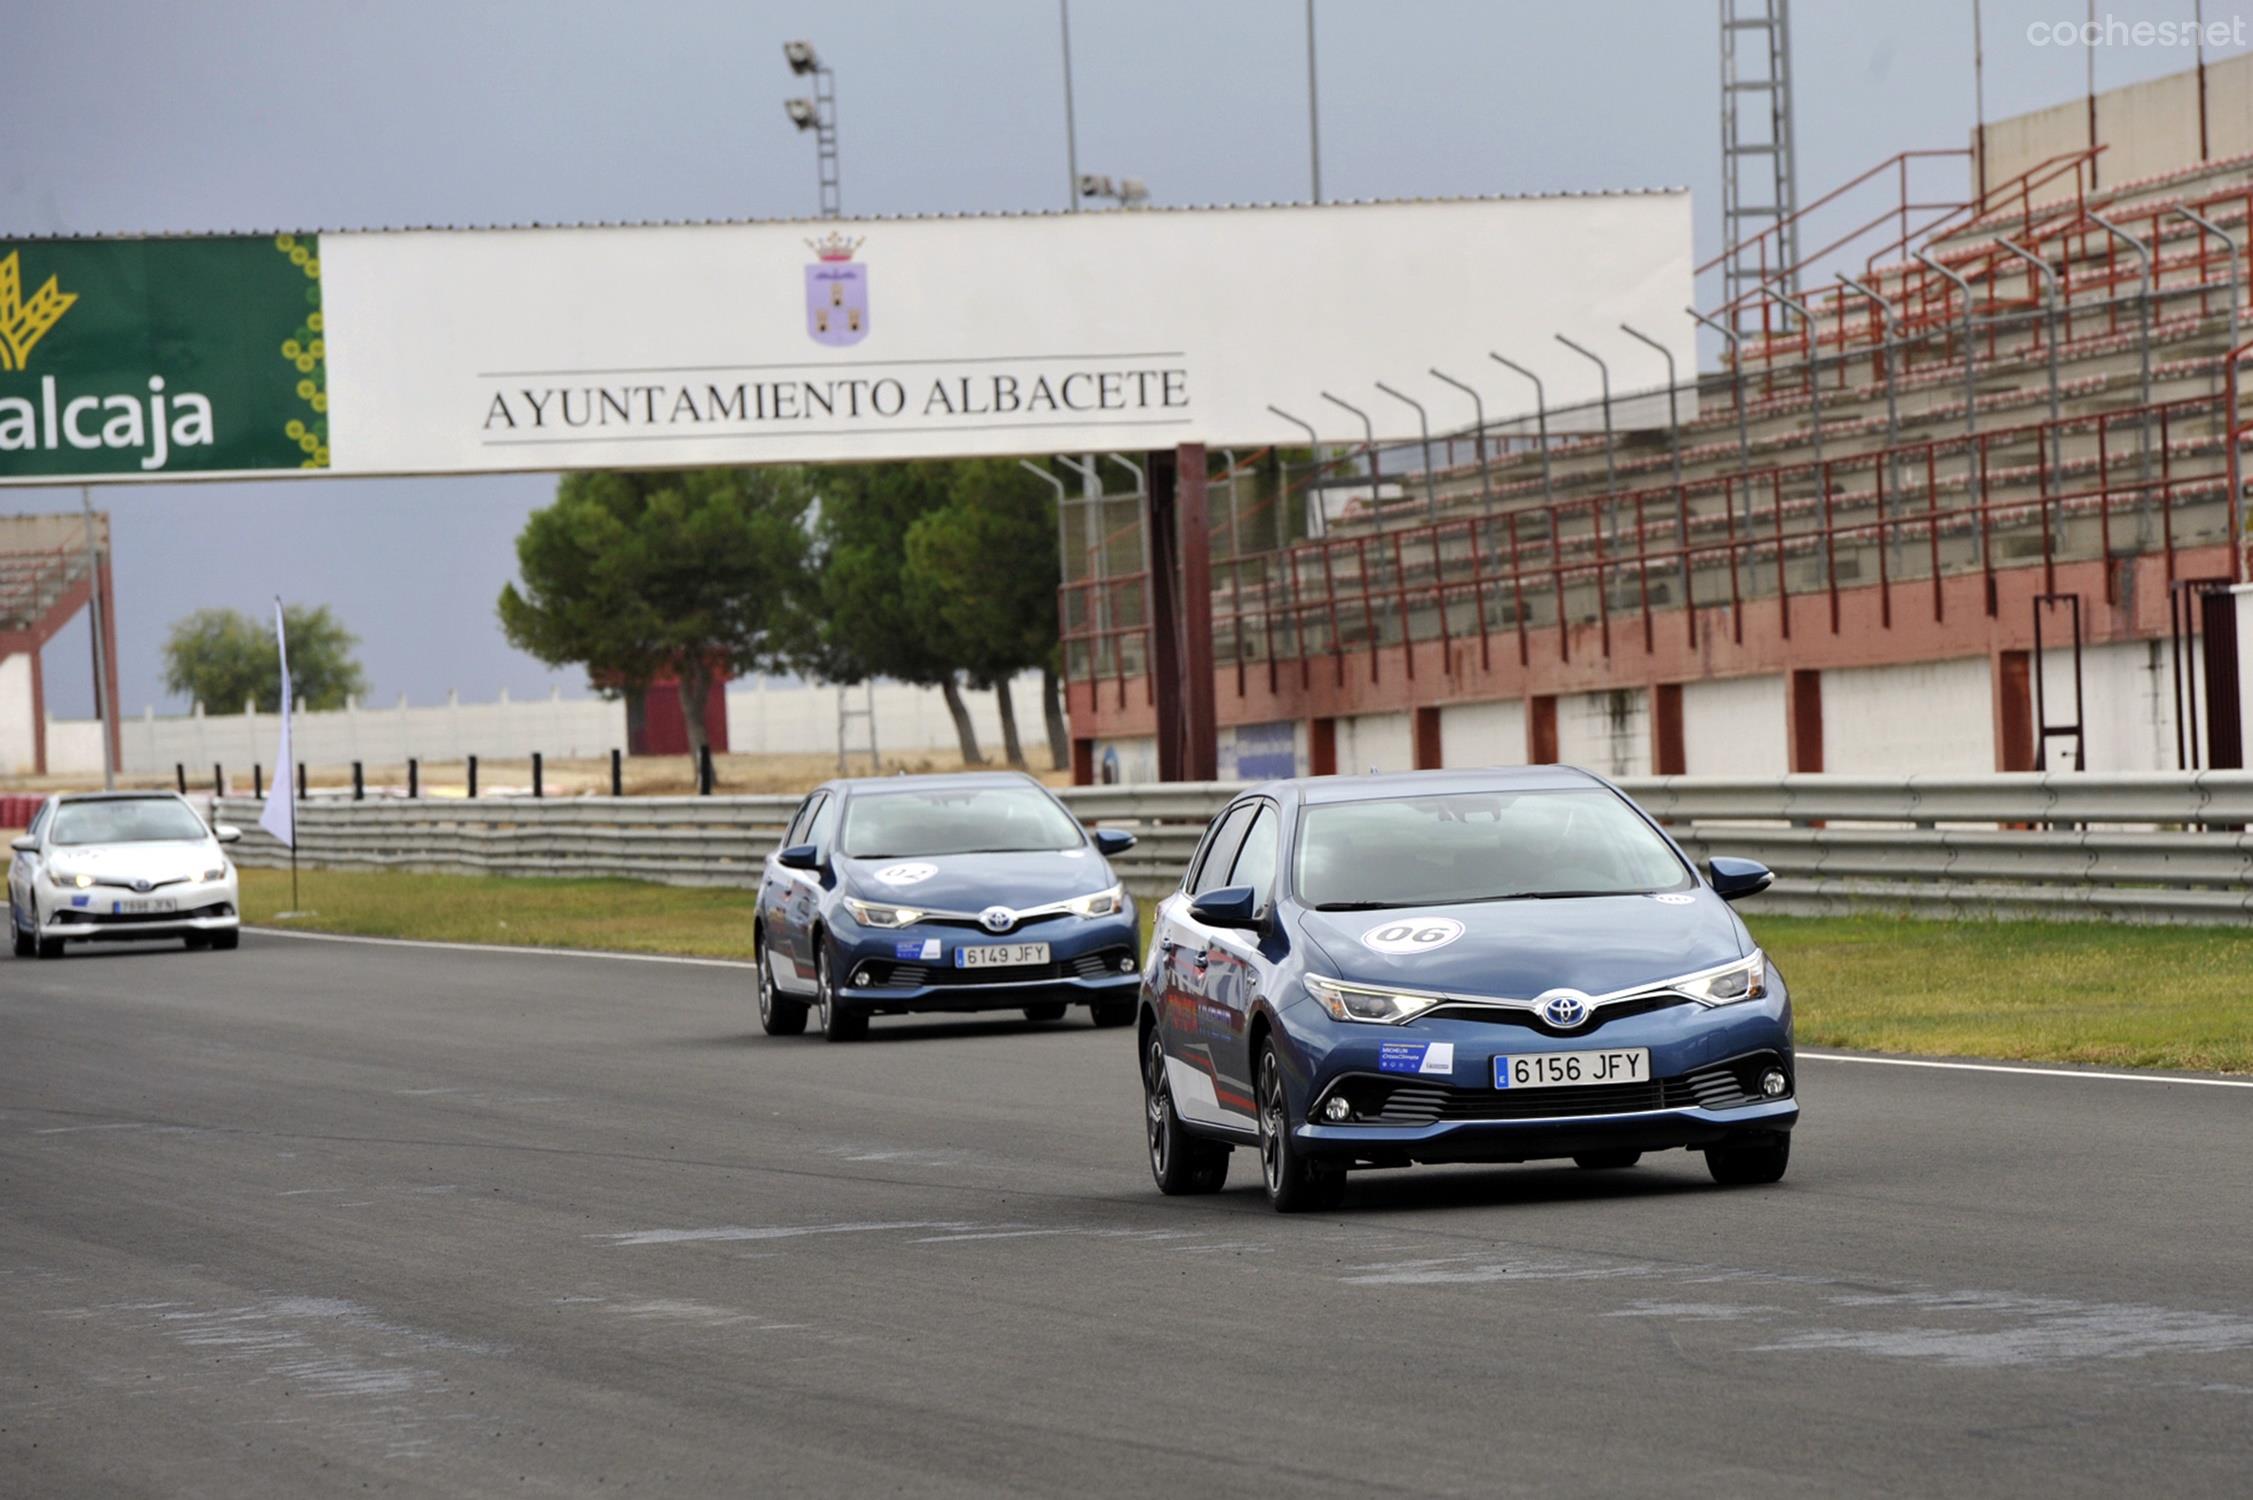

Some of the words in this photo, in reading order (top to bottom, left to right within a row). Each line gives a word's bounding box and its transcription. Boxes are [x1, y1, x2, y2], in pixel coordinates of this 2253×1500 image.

[483, 377, 906, 430] AYUNTAMIENTO
[923, 369, 1191, 416] ALBACETE
[0, 374, 215, 470] alcaja
[1376, 926, 1450, 943] 06
[967, 947, 1008, 964] 6149
[1015, 946, 1044, 962] JFY
[1515, 1057, 1581, 1083] 6156
[1592, 1053, 1640, 1080] JFY
